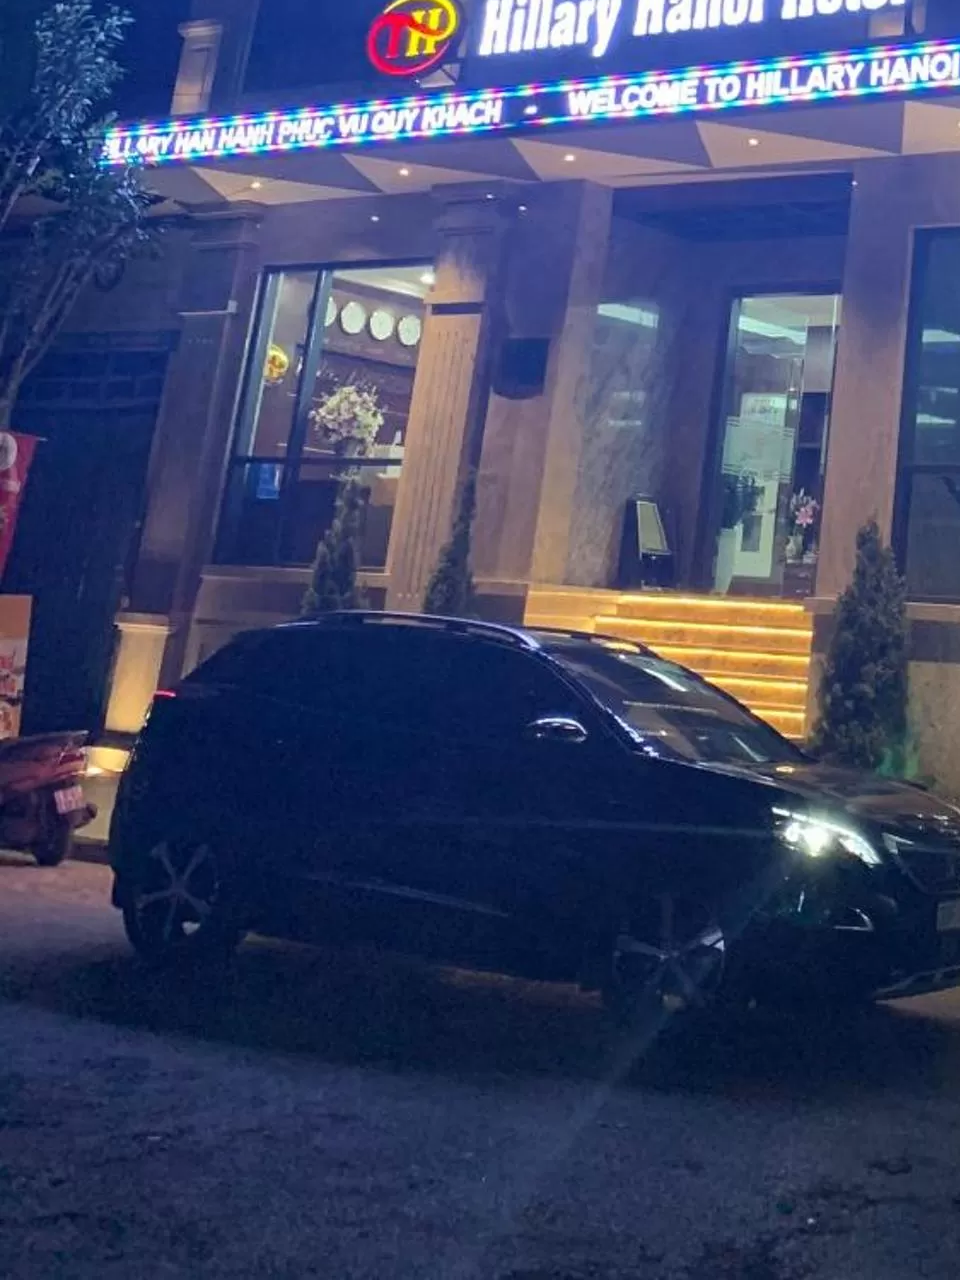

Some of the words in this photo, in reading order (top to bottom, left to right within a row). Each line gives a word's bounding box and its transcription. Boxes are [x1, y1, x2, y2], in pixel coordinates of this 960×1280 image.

[567, 77, 699, 116] WELCOME
[704, 75, 741, 103] TO
[744, 61, 866, 100] HILLARY
[870, 51, 960, 86] HANOI
